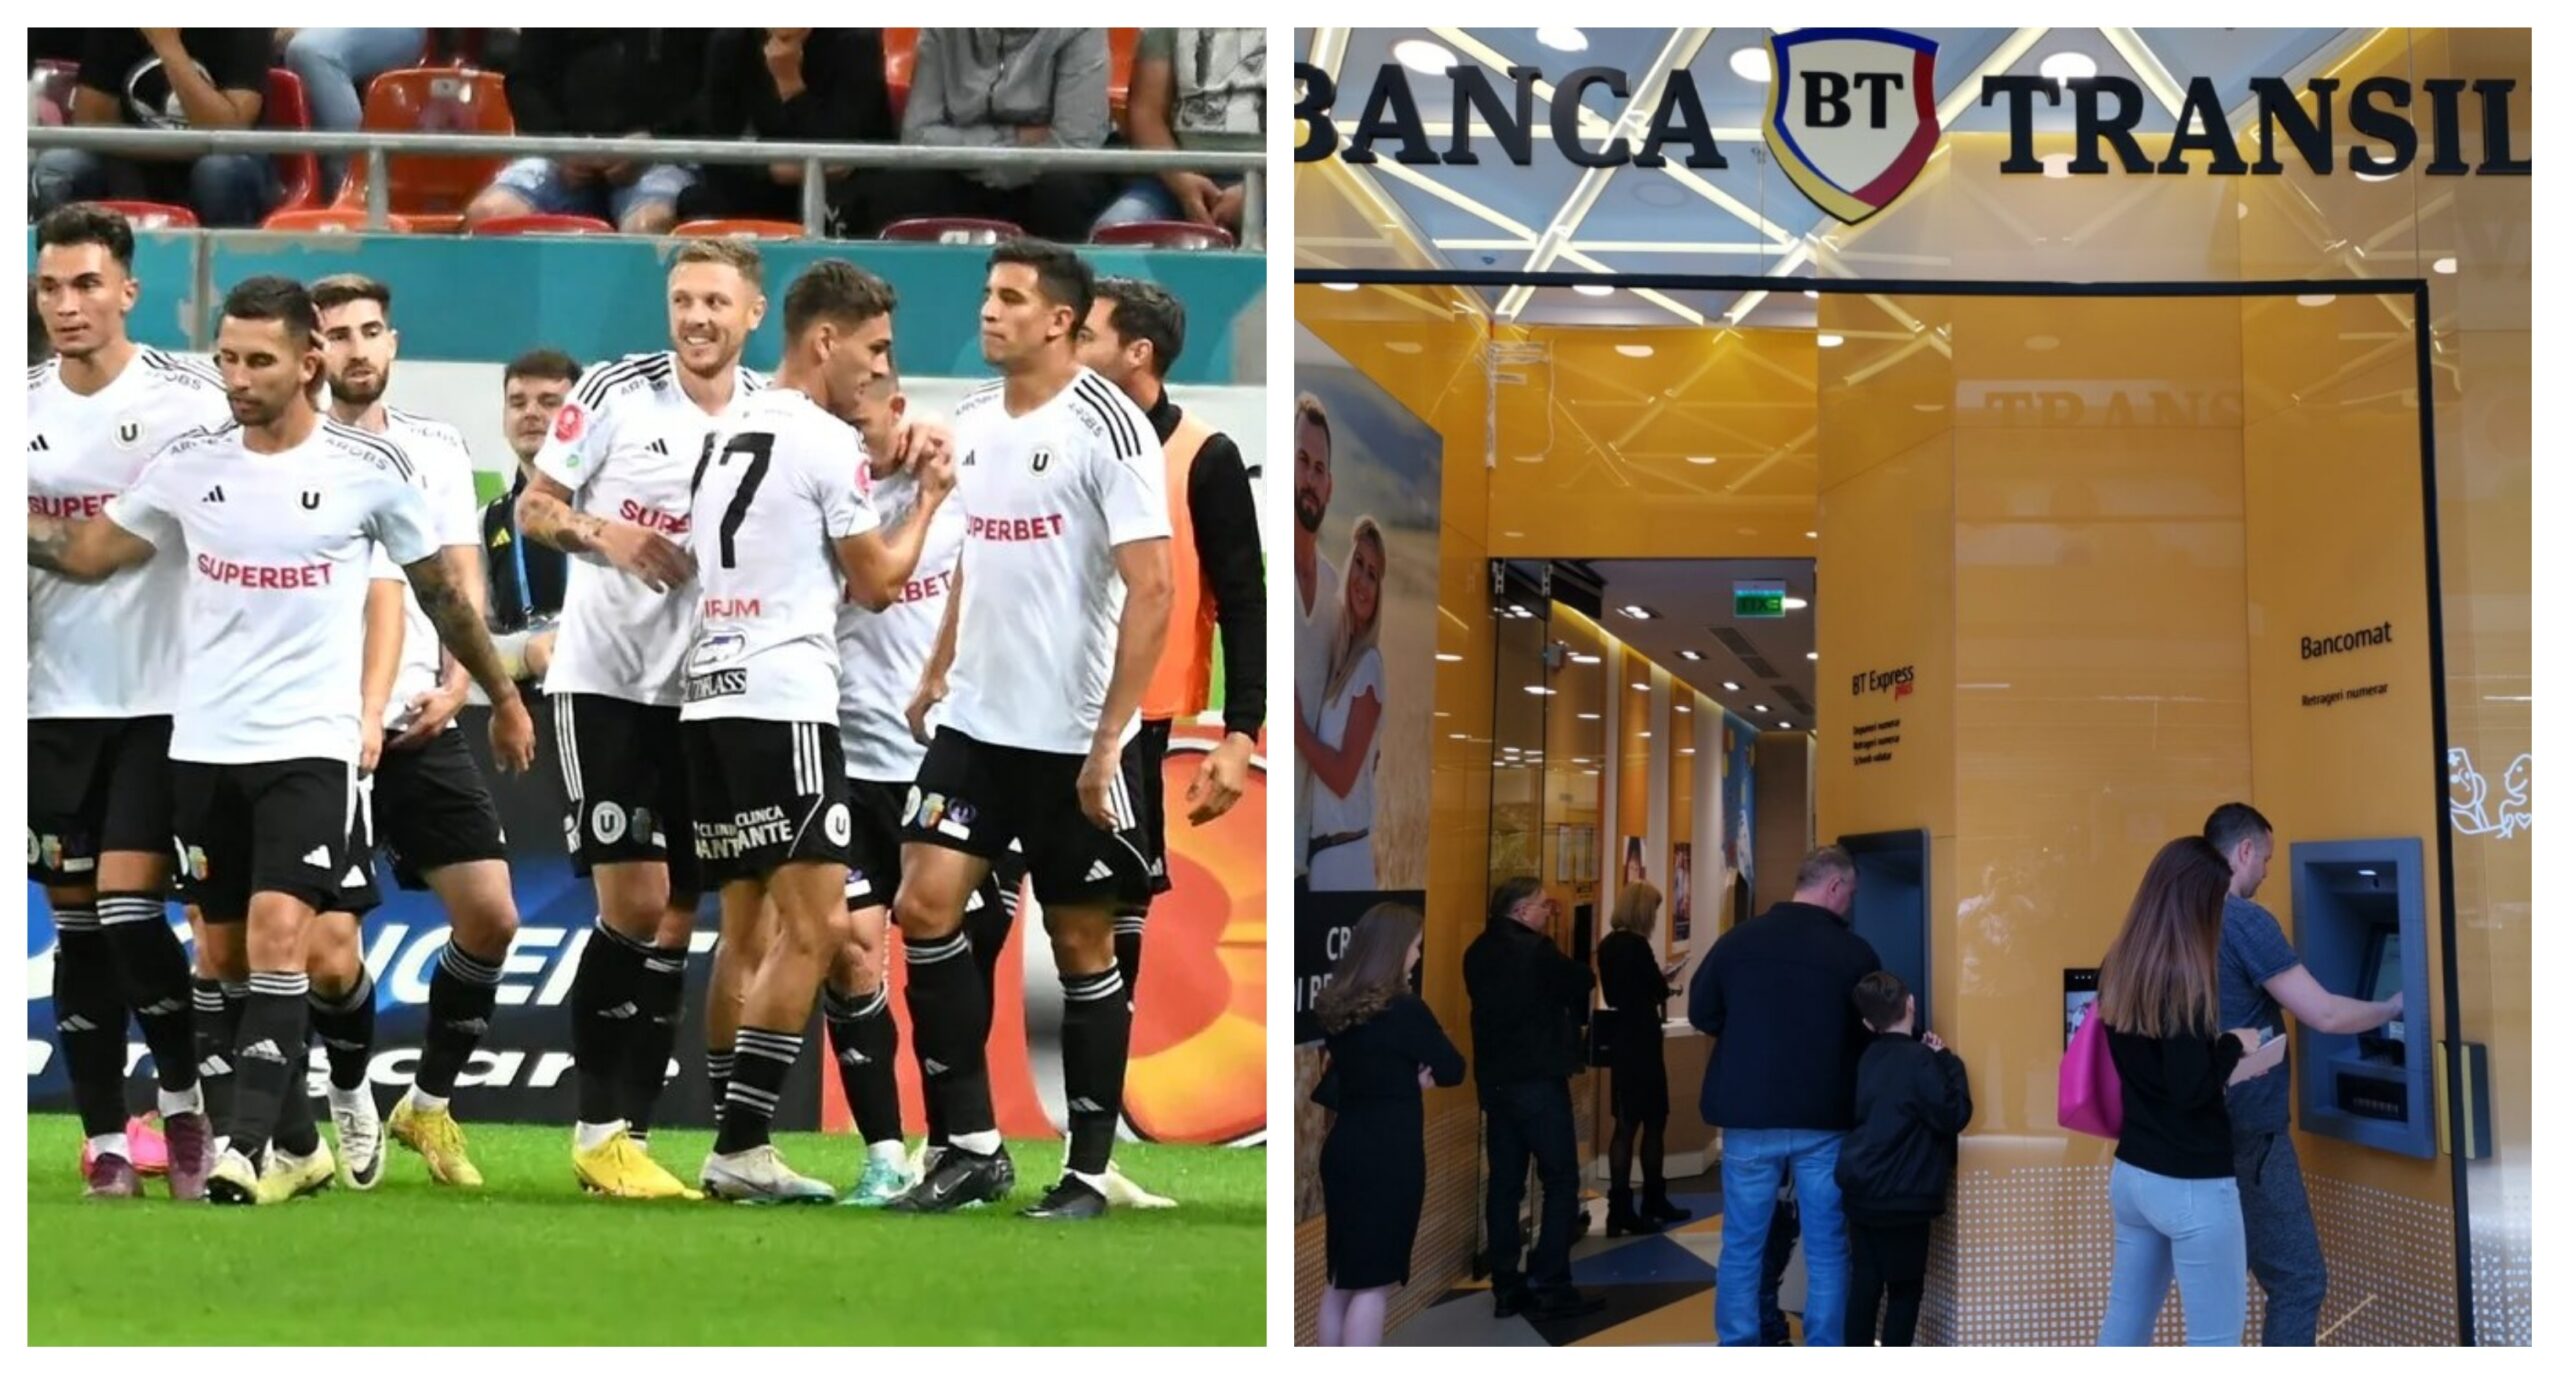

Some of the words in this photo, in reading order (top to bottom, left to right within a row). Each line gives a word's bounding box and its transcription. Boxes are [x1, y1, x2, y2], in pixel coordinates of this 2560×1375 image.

[1800, 70, 1904, 130] BT
[1981, 75, 2532, 176] TRANSIL
[121, 423, 138, 442] U
[1032, 453, 1049, 472] U
[302, 491, 320, 510] U
[197, 554, 333, 589] SUPERBET
[897, 570, 951, 603] BET
[2301, 621, 2392, 660] Bancomat
[1852, 673, 1866, 696] BT
[1869, 665, 1914, 693] Express
[2346, 684, 2388, 700] numerar
